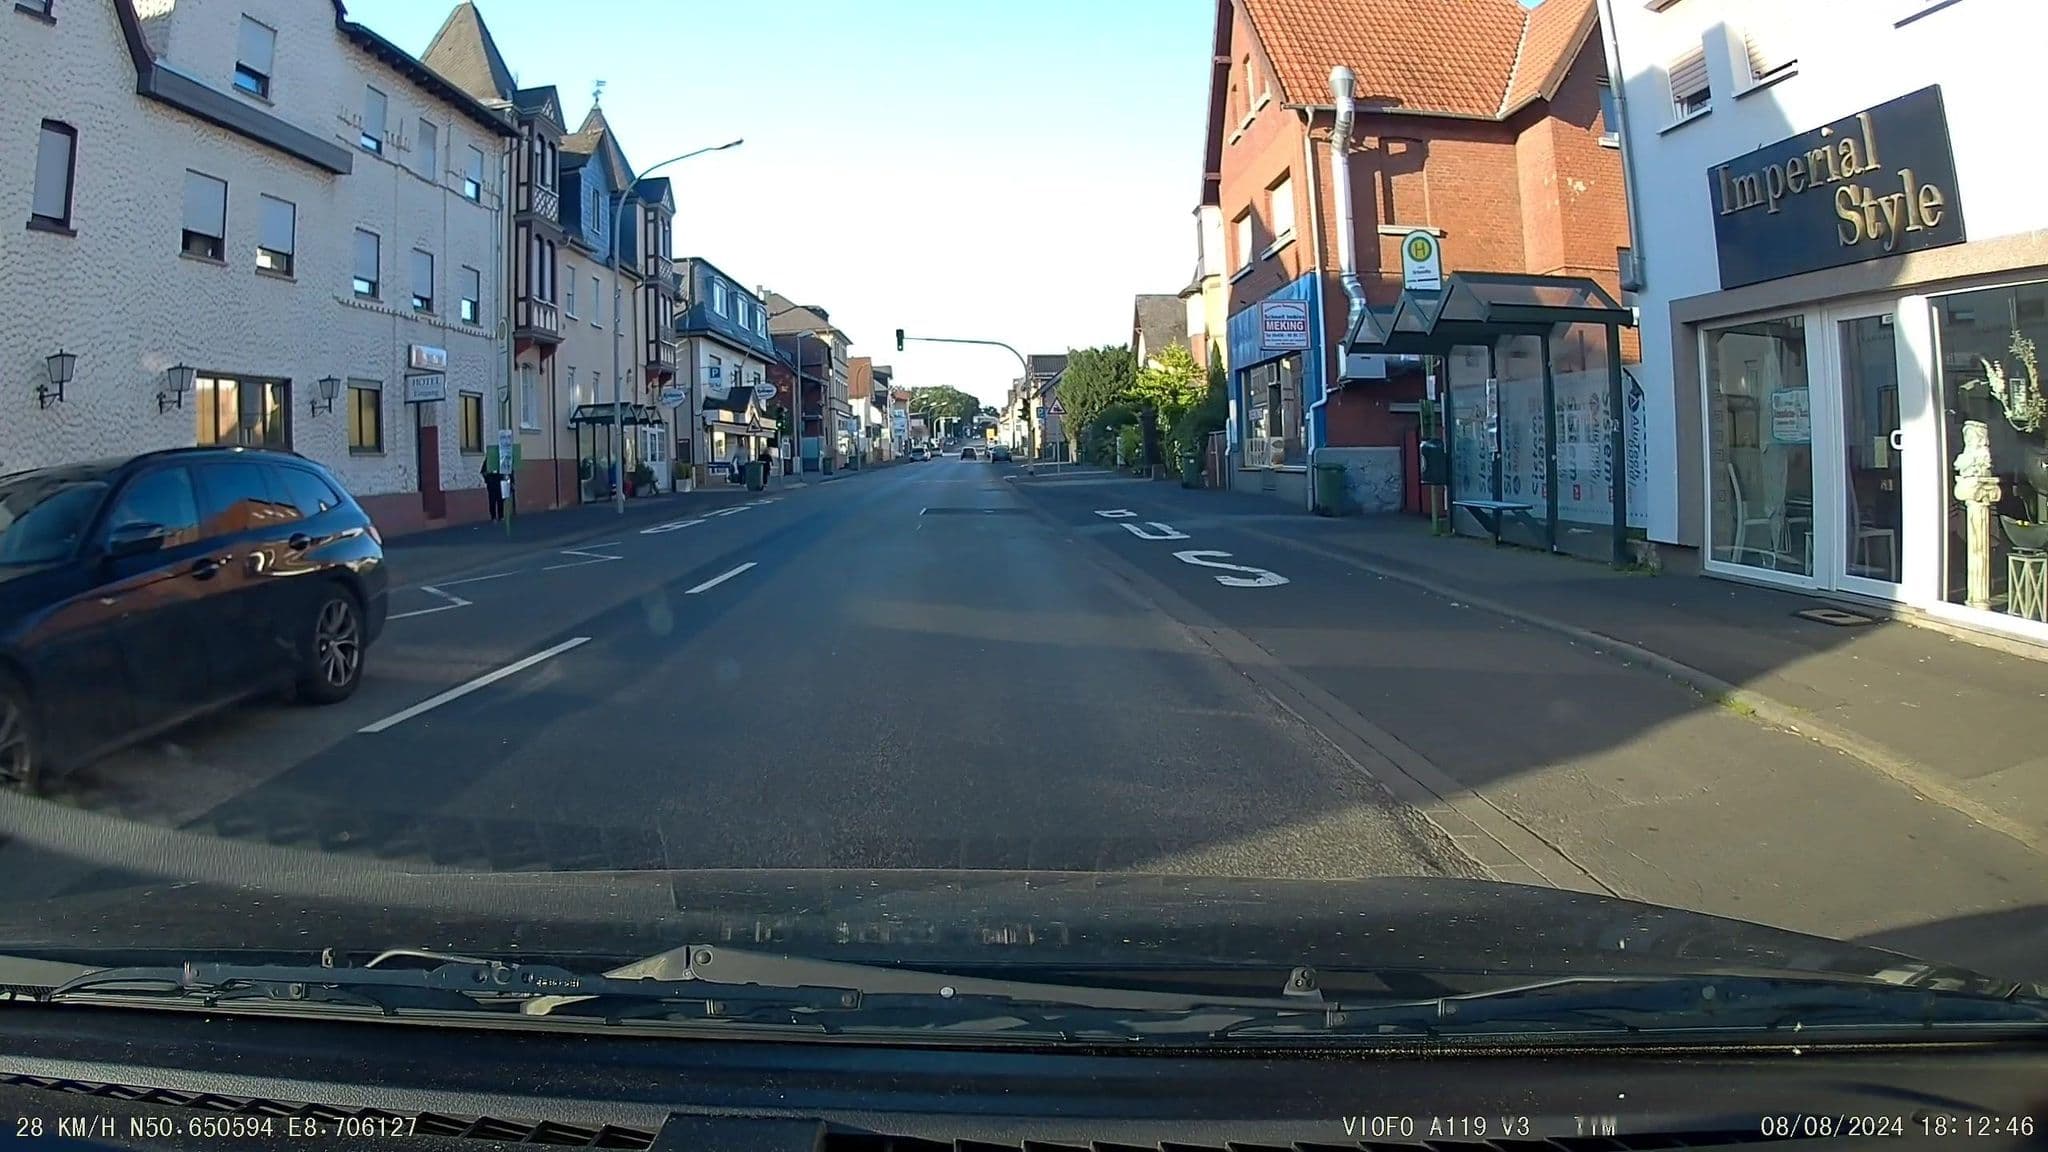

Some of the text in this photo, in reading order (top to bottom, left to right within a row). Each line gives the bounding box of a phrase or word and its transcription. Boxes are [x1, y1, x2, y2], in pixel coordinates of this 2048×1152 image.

[1716, 113, 1881, 217] Imperial
[1833, 168, 1945, 251] Style
[1414, 242, 1426, 257] H
[1266, 321, 1304, 331] MEKING
[412, 376, 440, 386] HOTEL
